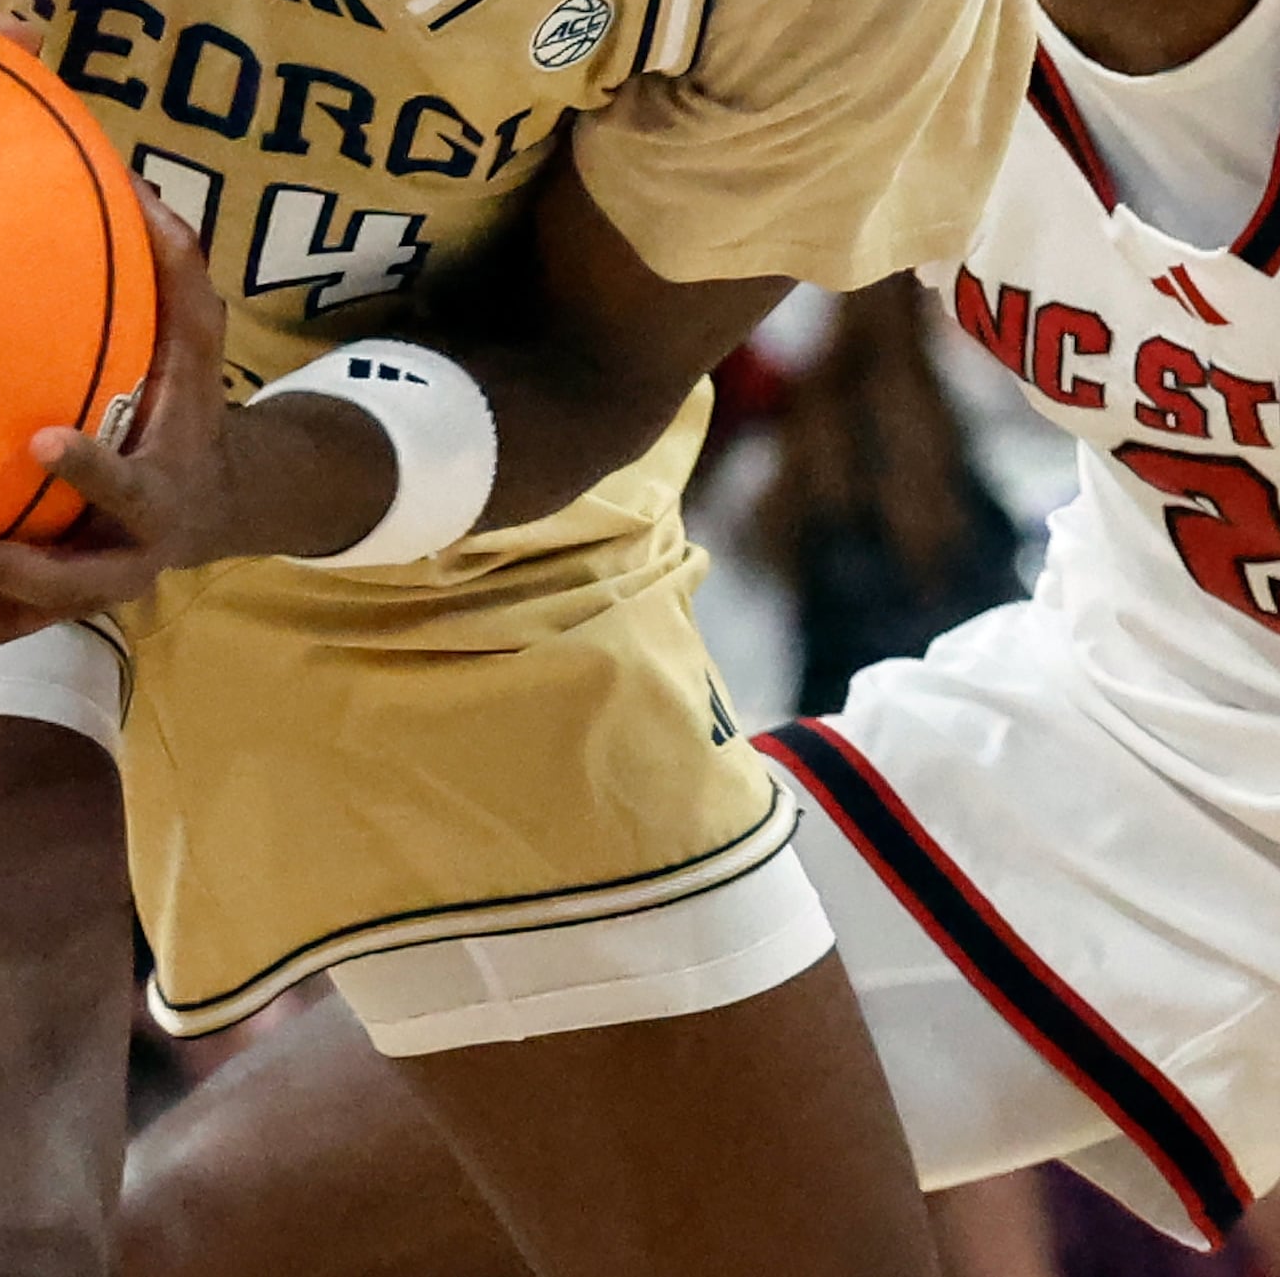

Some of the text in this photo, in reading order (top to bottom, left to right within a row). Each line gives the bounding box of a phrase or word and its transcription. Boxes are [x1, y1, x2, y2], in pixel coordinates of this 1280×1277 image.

[541, 10, 608, 44] ACC
[131, 143, 431, 320] 14
[955, 262, 1113, 409] NC
